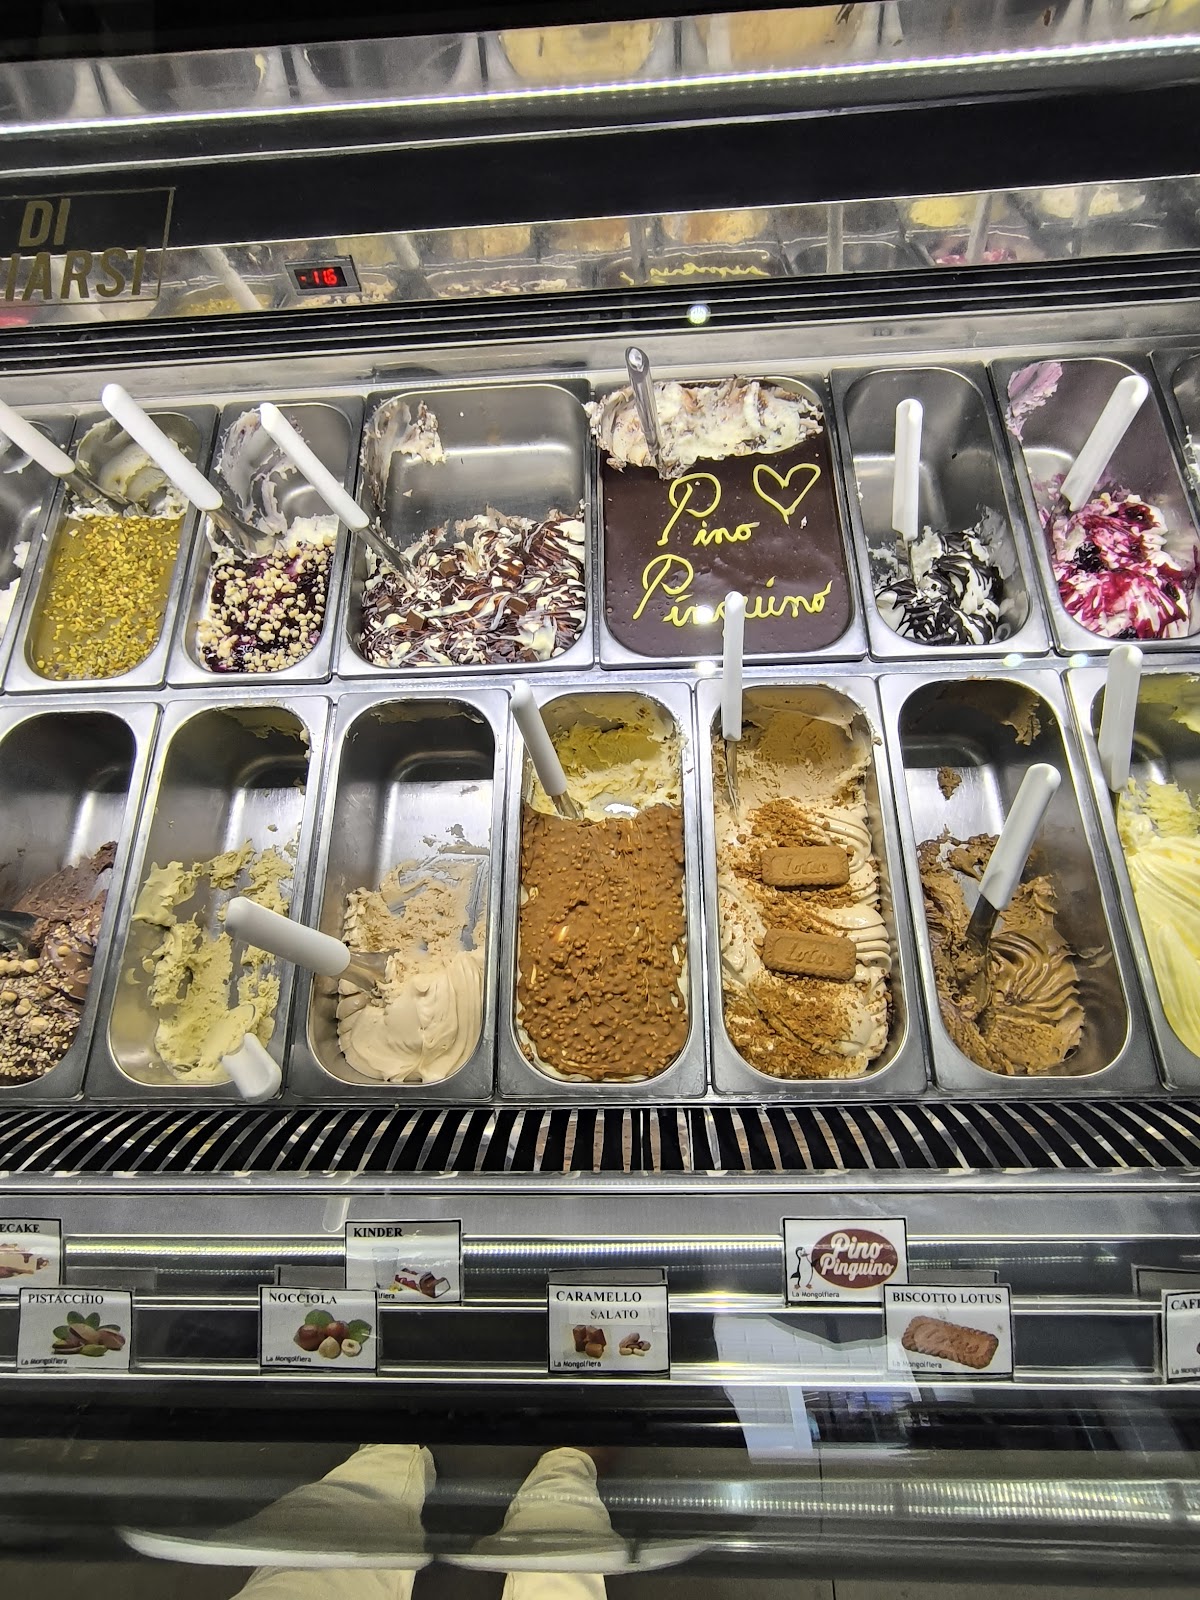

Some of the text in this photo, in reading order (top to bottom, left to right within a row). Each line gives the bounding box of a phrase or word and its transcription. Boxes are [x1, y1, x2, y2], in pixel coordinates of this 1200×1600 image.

[19, 198, 71, 247] DI
[657, 473, 760, 546] Pino
[353, 1227, 403, 1238] KINDER
[831, 1233, 884, 1260] Pino
[820, 1252, 894, 1281] Pinguino
[28, 1294, 104, 1305] PISTACCHIO
[269, 1292, 337, 1304] NOCCIOLA
[556, 1291, 642, 1302] CARAMELLO
[893, 1292, 1002, 1304] BISCOTTO LOTUS
[590, 1310, 639, 1319] SALATO
[563, 1361, 601, 1369] Mongolfiera
